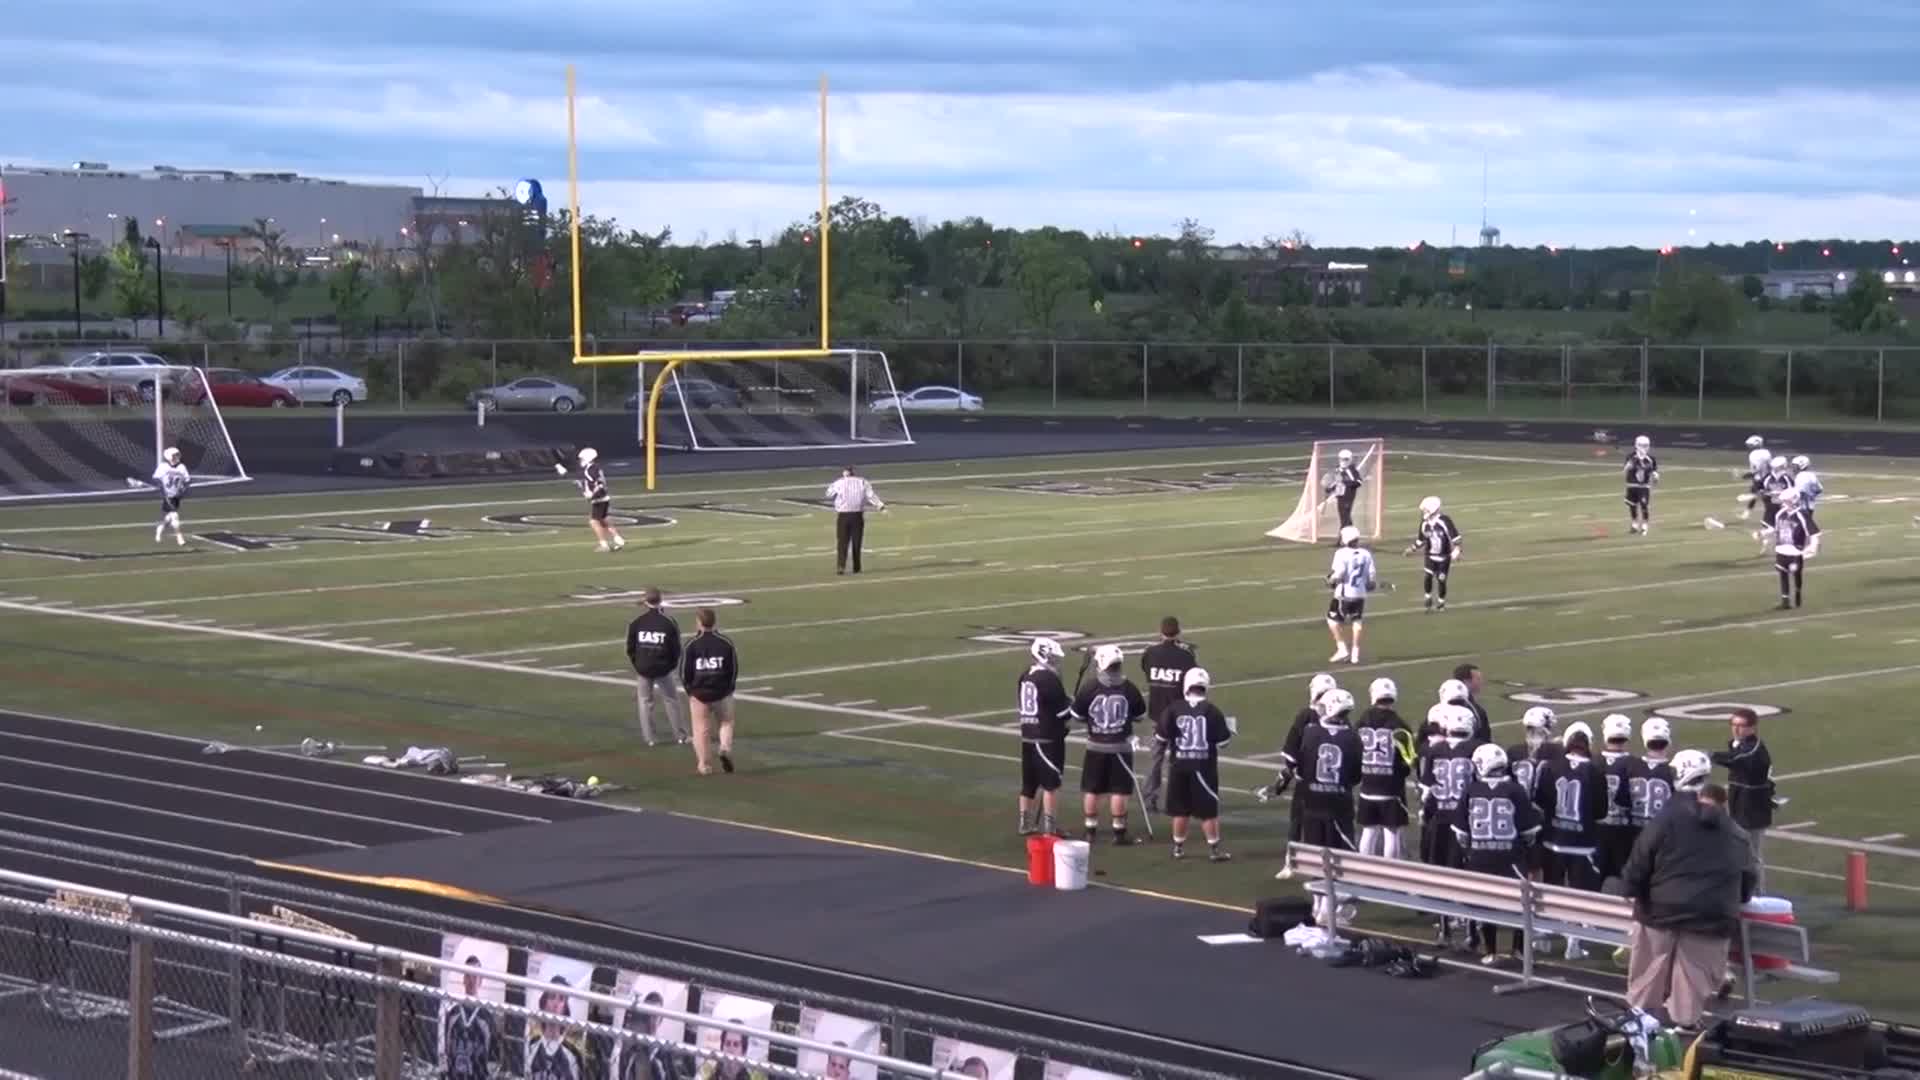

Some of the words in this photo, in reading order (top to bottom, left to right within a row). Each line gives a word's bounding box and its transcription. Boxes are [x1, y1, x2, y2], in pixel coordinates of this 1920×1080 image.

[637, 631, 667, 644] EAST
[695, 656, 725, 670] EAST
[1150, 667, 1182, 683] EAST
[1088, 694, 1130, 729] 40
[1175, 715, 1209, 751] 31
[1316, 743, 1343, 783] 2
[1468, 797, 1517, 839] 26
